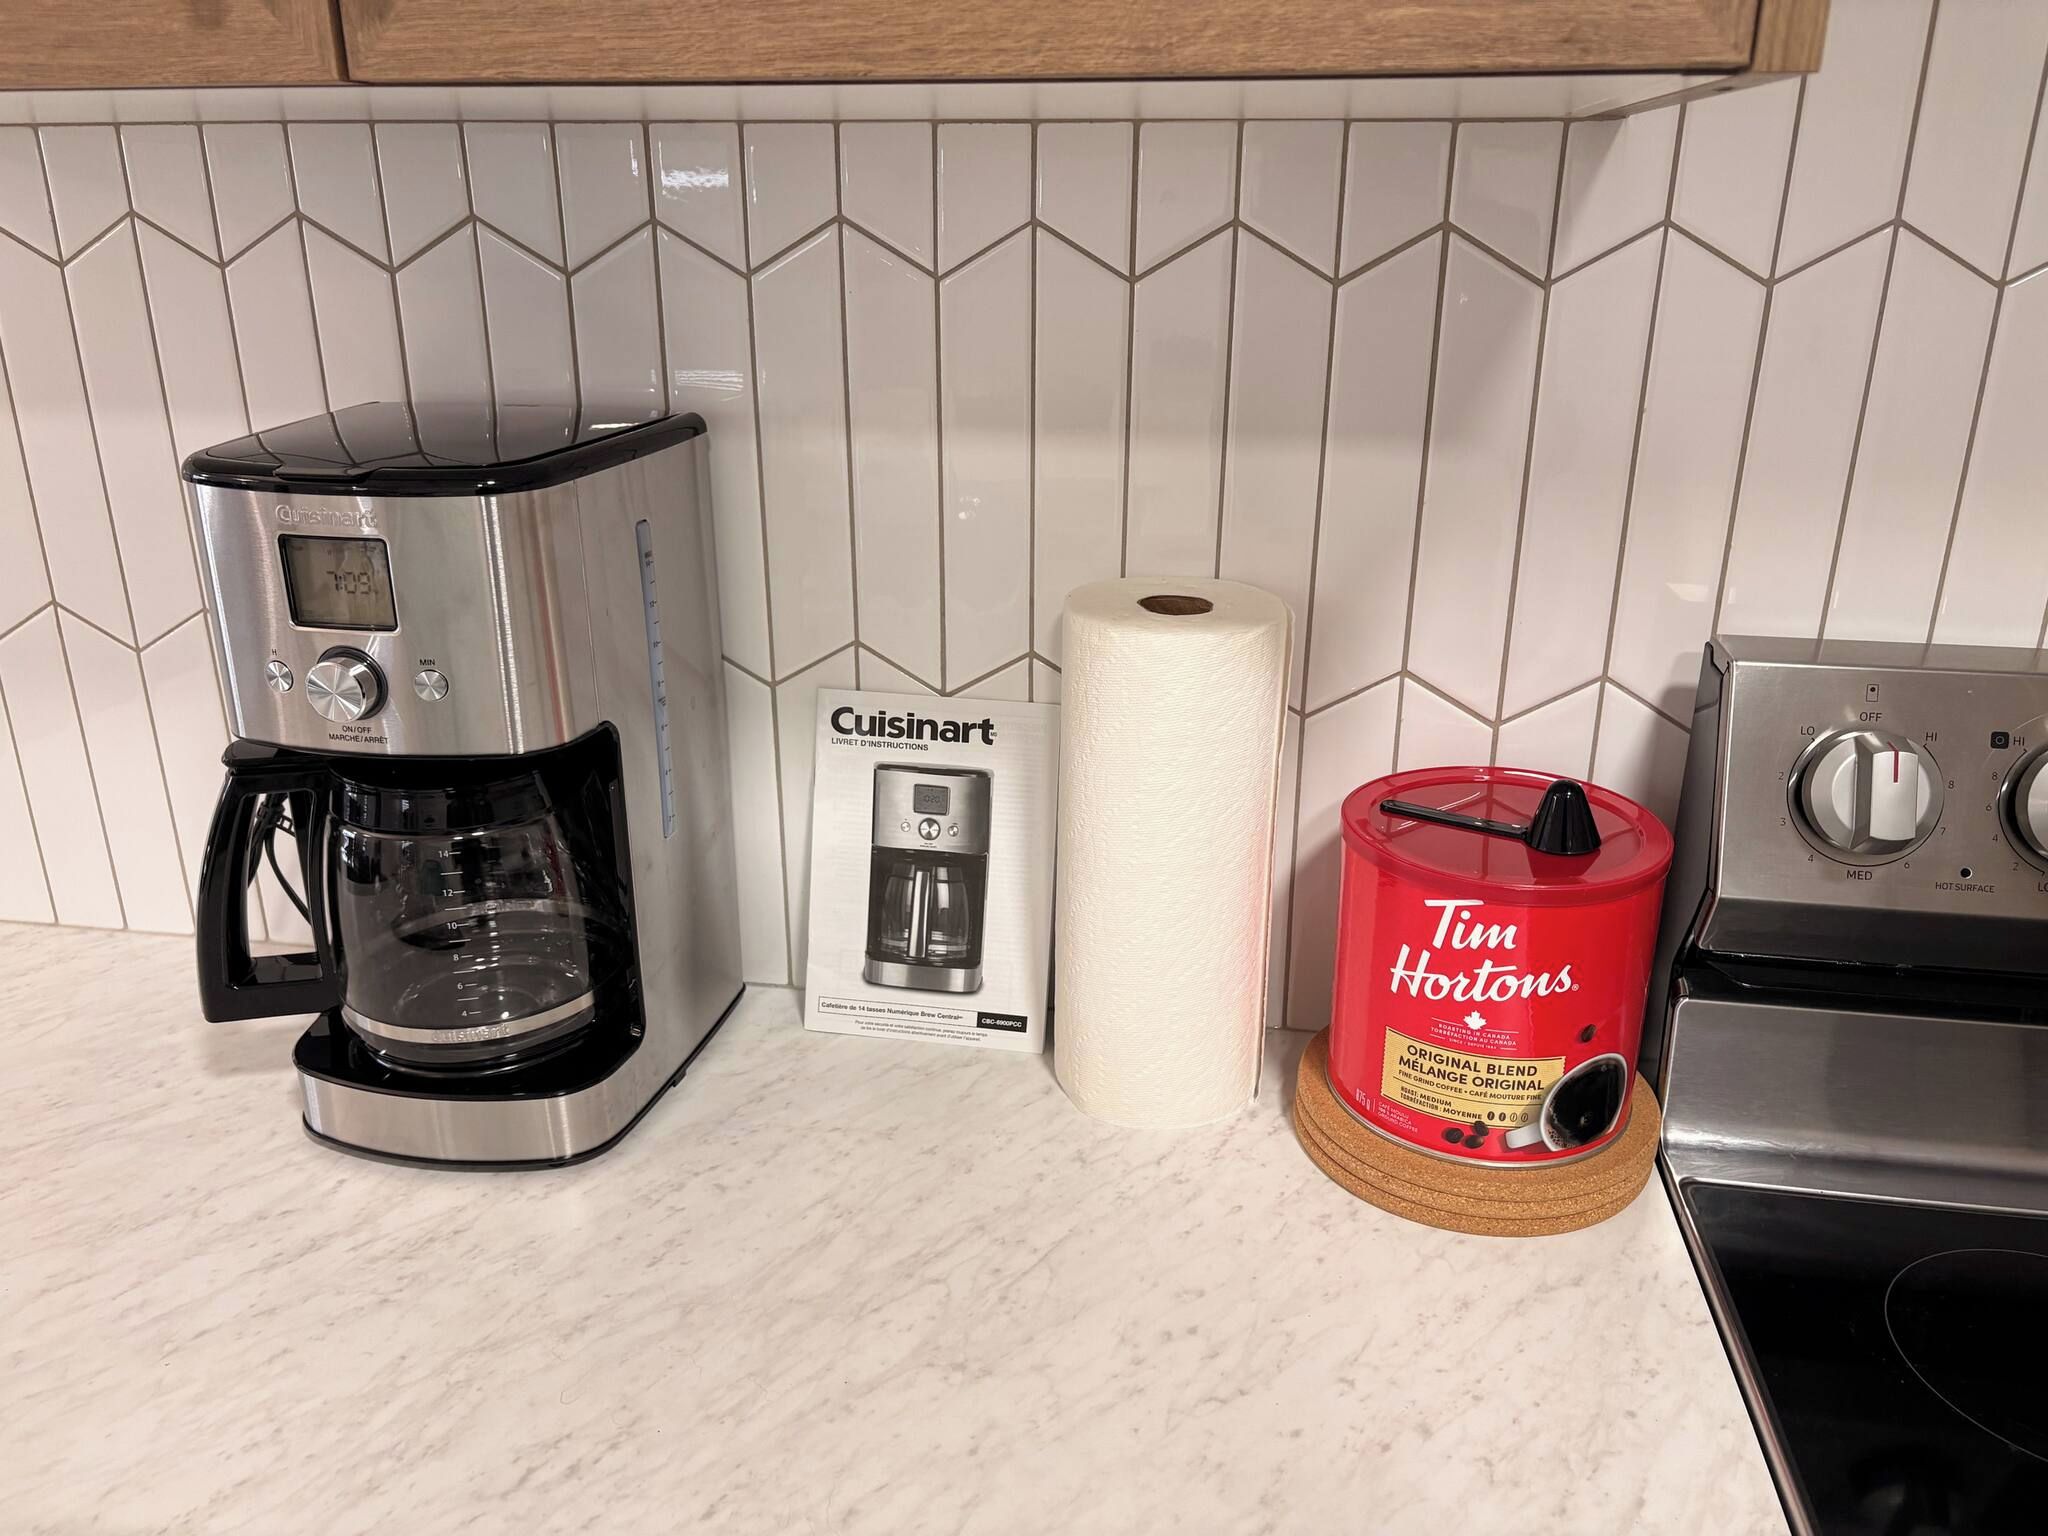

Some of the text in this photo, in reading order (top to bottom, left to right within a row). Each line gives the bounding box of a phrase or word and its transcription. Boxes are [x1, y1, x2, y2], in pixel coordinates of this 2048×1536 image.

[275, 504, 377, 529] Cuisinart
[420, 659, 436, 667] MIN
[1859, 711, 1883, 722] OFF
[831, 706, 994, 746] Cuisinart
[1800, 726, 1815, 736] LO
[1925, 731, 1938, 742] HI
[2013, 736, 2026, 747] HI
[831, 737, 929, 751] LIVRET D'INSTRUCTIONS
[1778, 771, 1785, 781] 2
[1991, 771, 1998, 781] 8
[1948, 780, 1955, 789] 8
[1985, 803, 1993, 812] 6
[1780, 817, 1787, 826] 3
[1940, 826, 1947, 836] 7
[1992, 833, 1999, 843] 4
[438, 850, 449, 859] 14
[1807, 854, 1814, 863] 4
[1904, 861, 1910, 869] 6
[2012, 862, 2019, 871] 2
[1846, 869, 1873, 880] MED
[442, 888, 454, 897] 12
[1935, 882, 1996, 894] HOT SURFACE
[447, 921, 458, 930] 10
[1424, 899, 1518, 950] Tim
[453, 953, 459, 961] 8
[457, 982, 463, 990] 6
[920, 1010, 936, 1018] Brew
[1438, 1024, 1472, 1035] ROASTING
[1407, 1044, 1538, 1077] ORIGINAL BLEND
[1399, 1055, 1545, 1091] MÉLANGE ORIGINAL
[1399, 1069, 1413, 1080] FINE
[1413, 1075, 1435, 1087] GRIND
[1436, 1082, 1463, 1094] COFFEE
[1469, 1089, 1488, 1098] CAFÉ
[1489, 1092, 1526, 1101] MOUTURE
[1420, 1093, 1452, 1107] MEDIUM
[1443, 1107, 1483, 1120] MOYENNE
